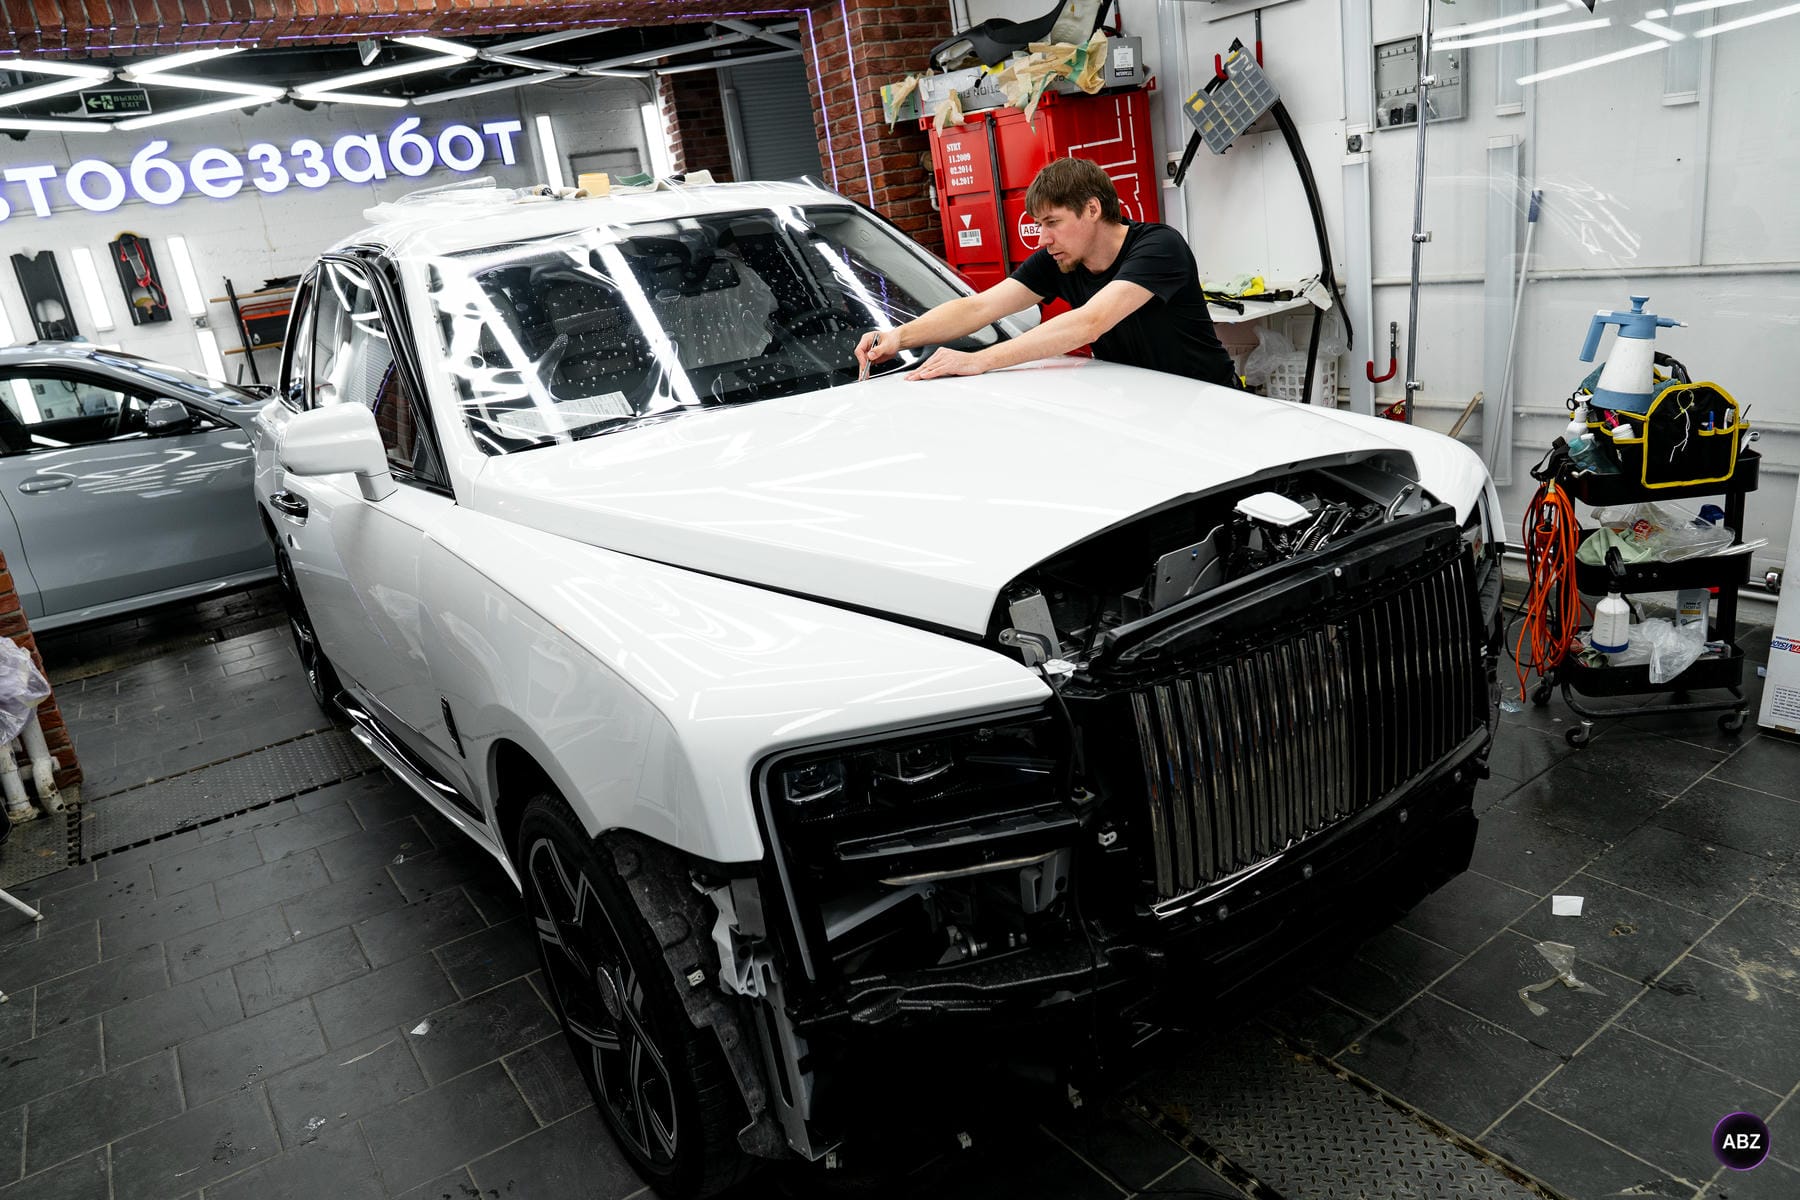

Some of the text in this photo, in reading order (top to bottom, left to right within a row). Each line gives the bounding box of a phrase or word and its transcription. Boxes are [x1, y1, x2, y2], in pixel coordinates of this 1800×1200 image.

[113, 95, 145, 103] ВЫХОД
[0, 117, 521, 222] тобеззабот
[950, 165, 973, 175] 02.2014
[951, 176, 974, 186] 04.2017
[1023, 225, 1040, 235] ABZ
